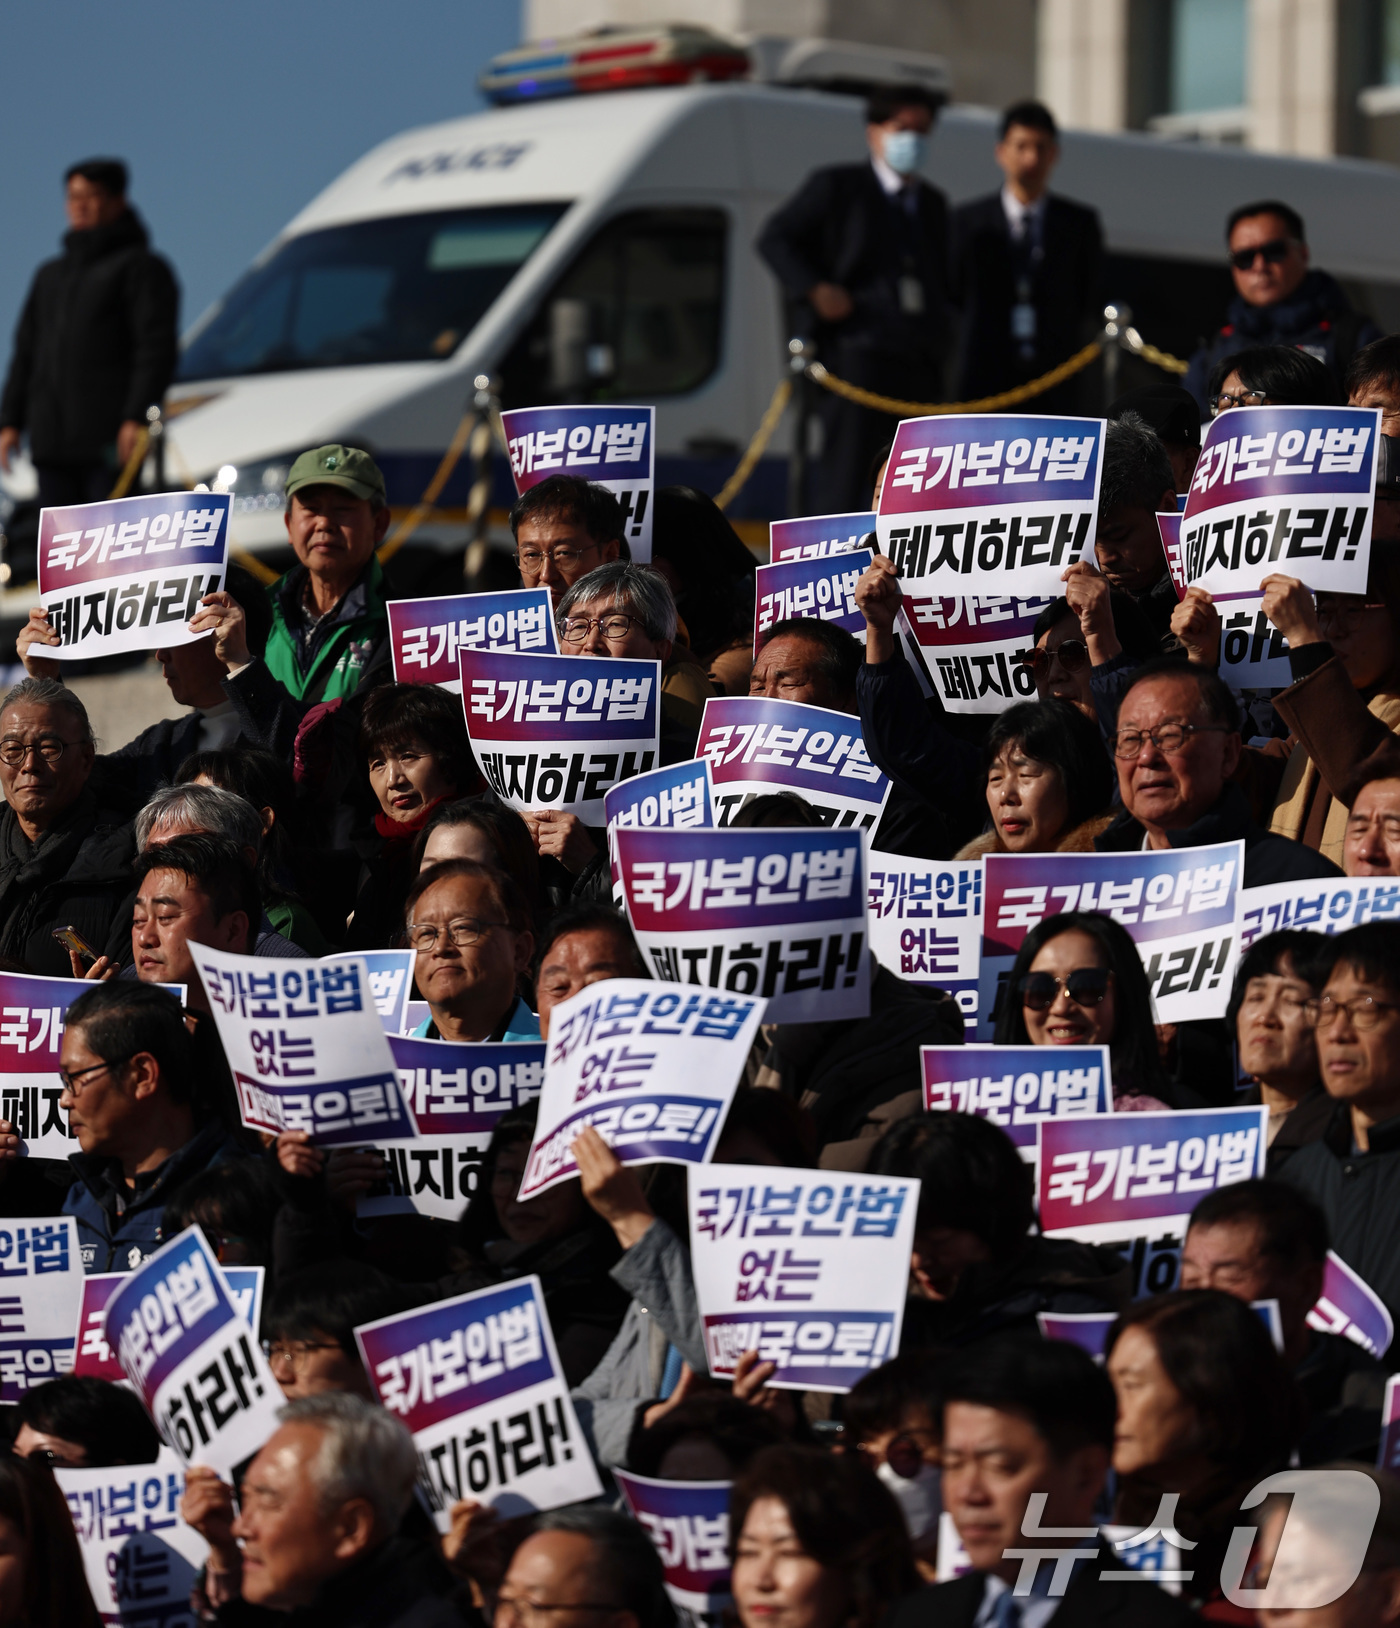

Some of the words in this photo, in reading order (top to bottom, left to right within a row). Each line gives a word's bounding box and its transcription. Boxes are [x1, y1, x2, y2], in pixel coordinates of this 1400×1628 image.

[508, 422, 647, 478] 국가보안법
[891, 436, 1095, 493] 국가보안법
[1192, 427, 1371, 494] 국가보안법
[47, 508, 225, 571] 국가보안법
[889, 513, 1092, 579] 폐지하라!
[1186, 507, 1368, 582] 폐지하라!
[401, 605, 547, 669] 국가보안법
[470, 677, 652, 723] 국가보안법
[631, 847, 857, 912] 국가보안법
[868, 869, 982, 918] 국가보안
[900, 928, 959, 973] 없는
[202, 963, 364, 1019] 국가보안법
[250, 1028, 316, 1078] 없는
[551, 991, 755, 1065] 국가보안법
[574, 1045, 657, 1103] 없는
[1047, 1127, 1258, 1206] 국가보안법
[696, 1185, 909, 1241] 국가보안법
[734, 1249, 822, 1302] 없는
[375, 1299, 543, 1415] 국가보안법
[66, 1473, 184, 1544] 국가보안
[106, 1545, 169, 1604] 없는
